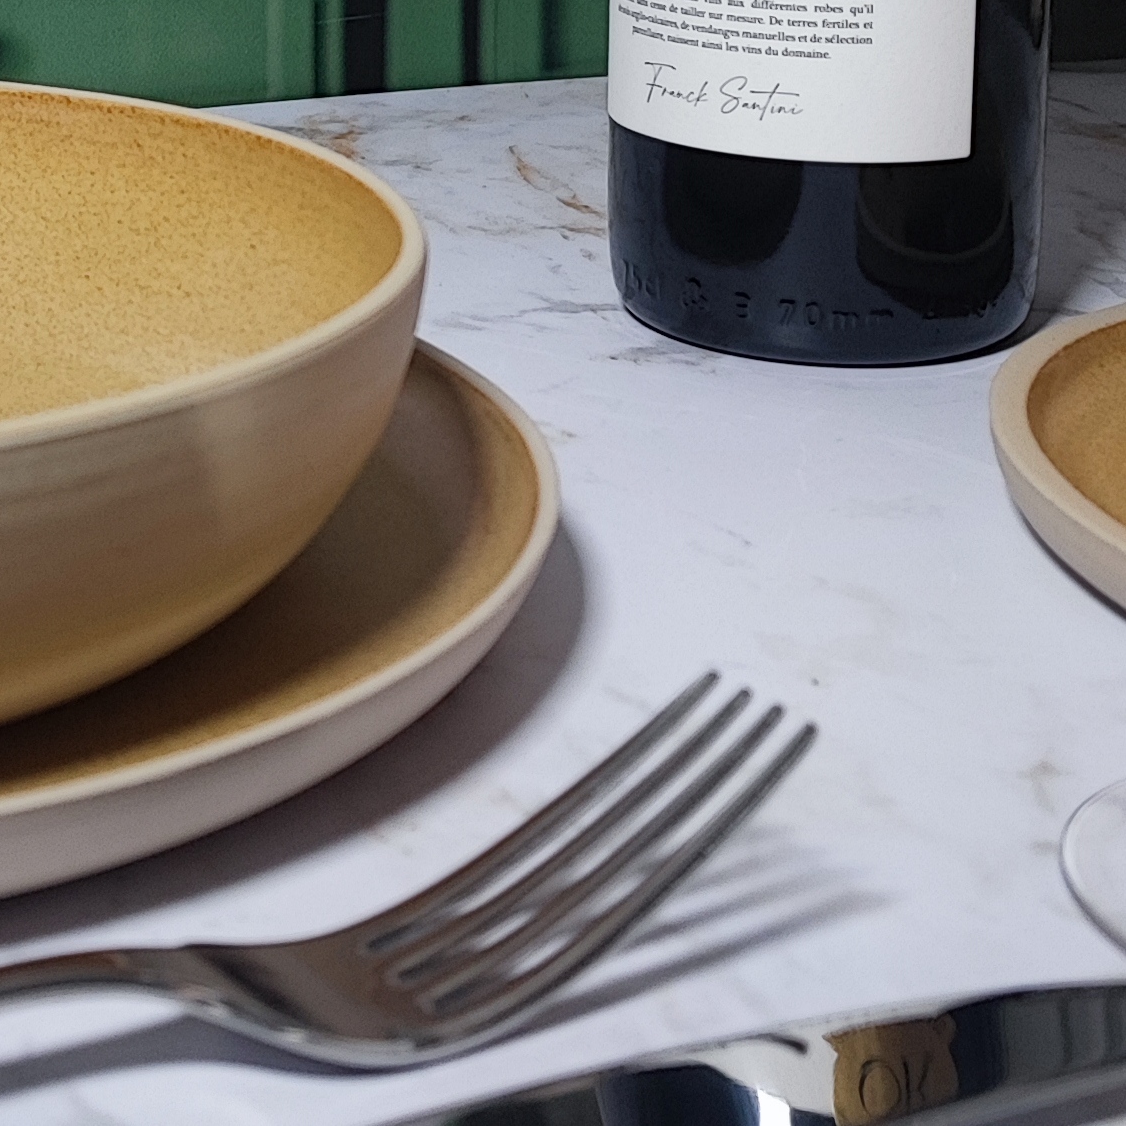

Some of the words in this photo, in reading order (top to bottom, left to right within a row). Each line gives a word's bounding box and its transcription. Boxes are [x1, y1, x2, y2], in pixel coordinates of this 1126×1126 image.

[669, 3, 679, 13] de
[709, 12, 723, 20] sur
[769, 15, 784, 26] De
[787, 19, 818, 28] terres
[822, 19, 860, 29] fertiles
[863, 21, 873, 30] et
[727, 0, 744, 8] aux
[751, 0, 807, 12] différentes
[814, 3, 844, 13] robes
[849, 4, 874, 17] qu'il
[692, 24, 740, 39] vendanges
[741, 30, 796, 42] manuelles
[798, 34, 807, 43] et
[810, 33, 822, 44] de
[824, 34, 873, 44] sélection
[725, 41, 739, 52] les
[742, 45, 762, 54] vins
[765, 46, 778, 56] du
[781, 47, 831, 59] domaine.
[644, 61, 709, 108] Franck
[719, 75, 804, 121] Santini
